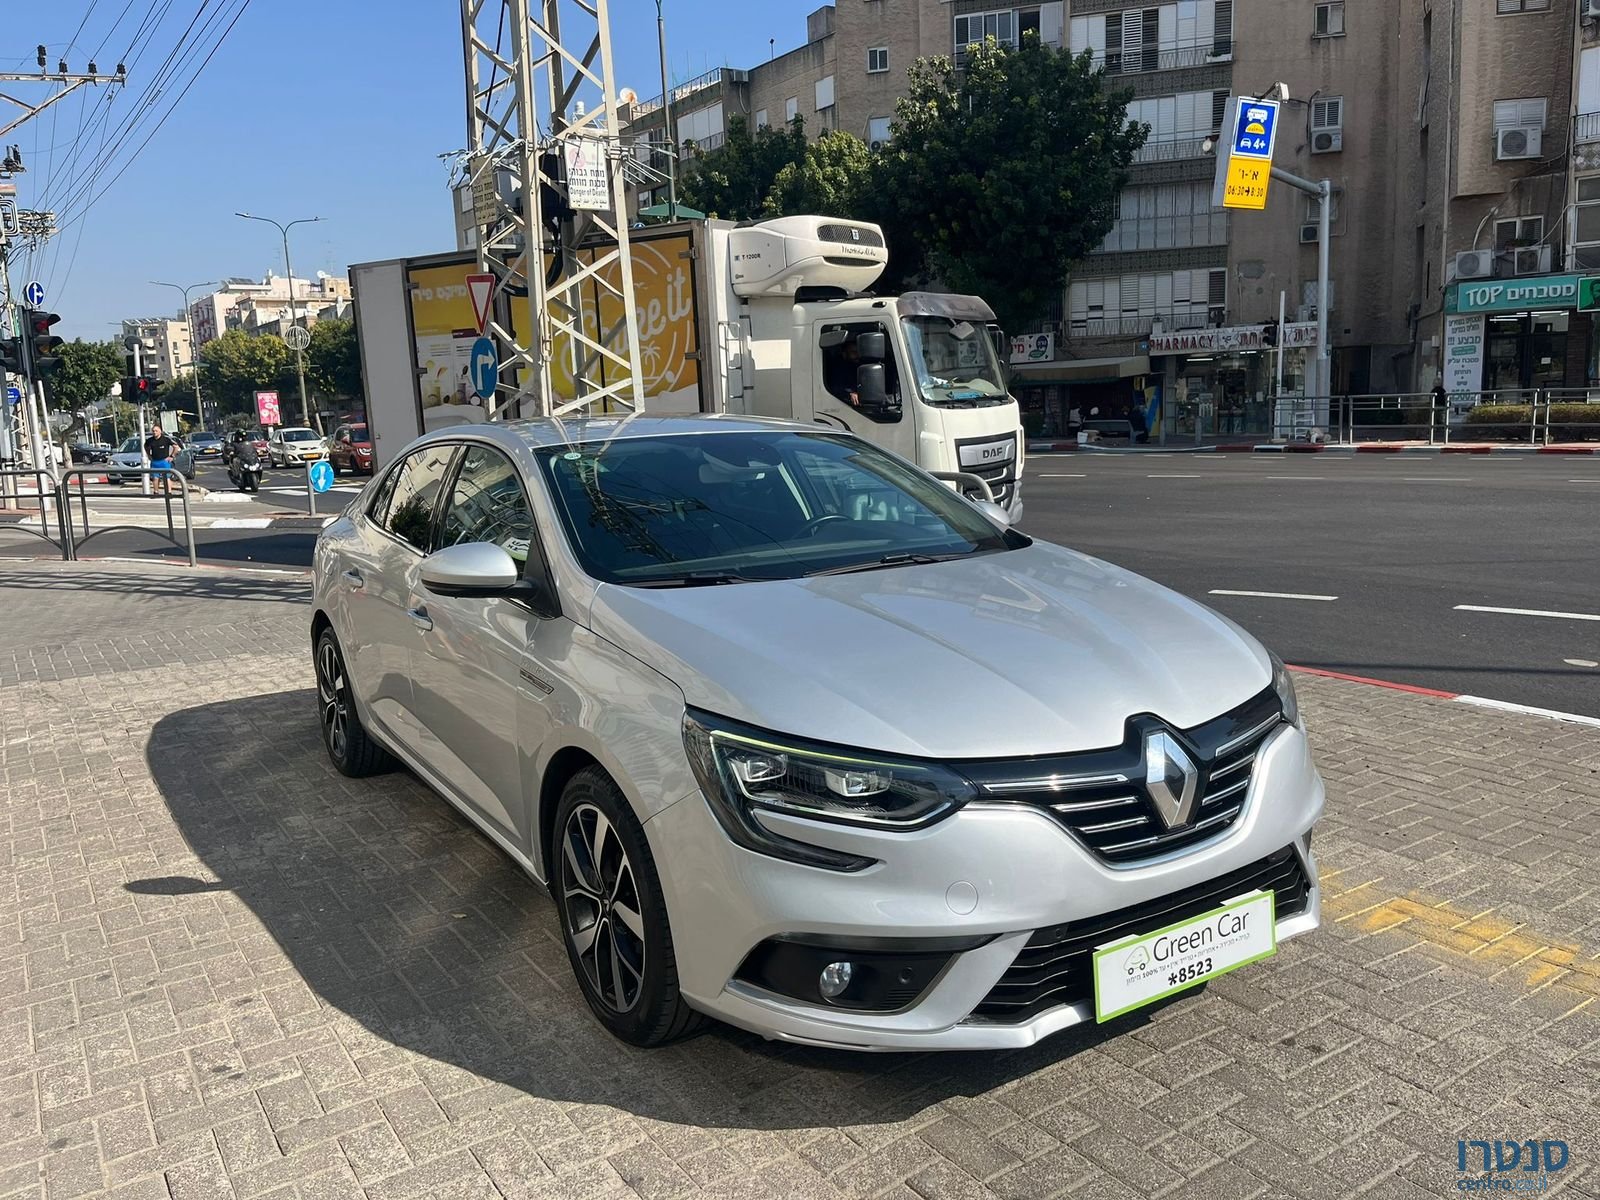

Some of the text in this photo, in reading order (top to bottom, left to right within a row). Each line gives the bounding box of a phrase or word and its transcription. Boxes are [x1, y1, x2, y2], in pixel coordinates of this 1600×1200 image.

[1465, 285, 1503, 306] TOP
[1149, 335, 1214, 351] PHARMACY
[1457, 335, 1481, 345] מבצע
[982, 447, 1003, 459] DAF
[1153, 911, 1250, 962] Green Car
[1142, 968, 1159, 979] 100%
